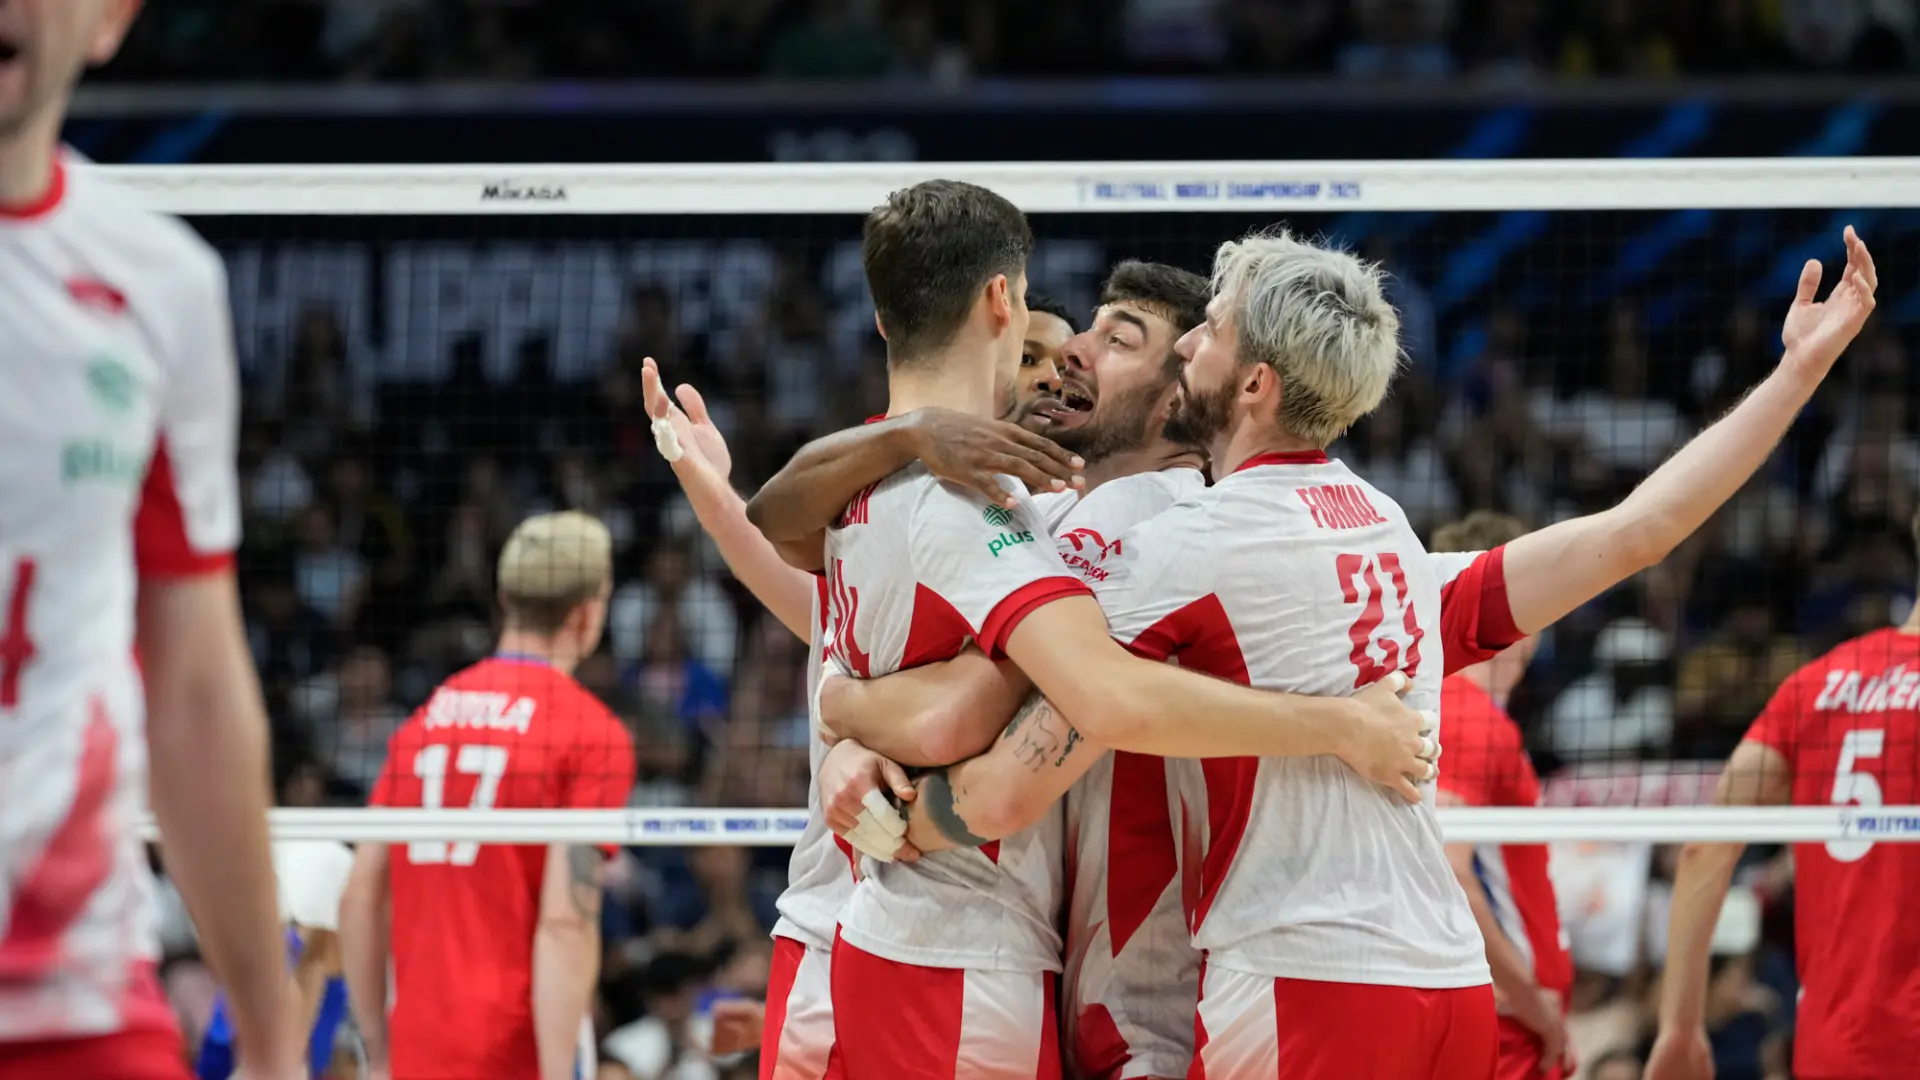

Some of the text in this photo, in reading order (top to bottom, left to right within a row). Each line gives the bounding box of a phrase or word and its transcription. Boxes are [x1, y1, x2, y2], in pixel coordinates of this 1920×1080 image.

[987, 530, 1035, 558] plus
[1295, 484, 1389, 530] FORNAL
[1336, 552, 1425, 690] 21
[407, 743, 509, 866] 17
[1826, 729, 1885, 862] 5
